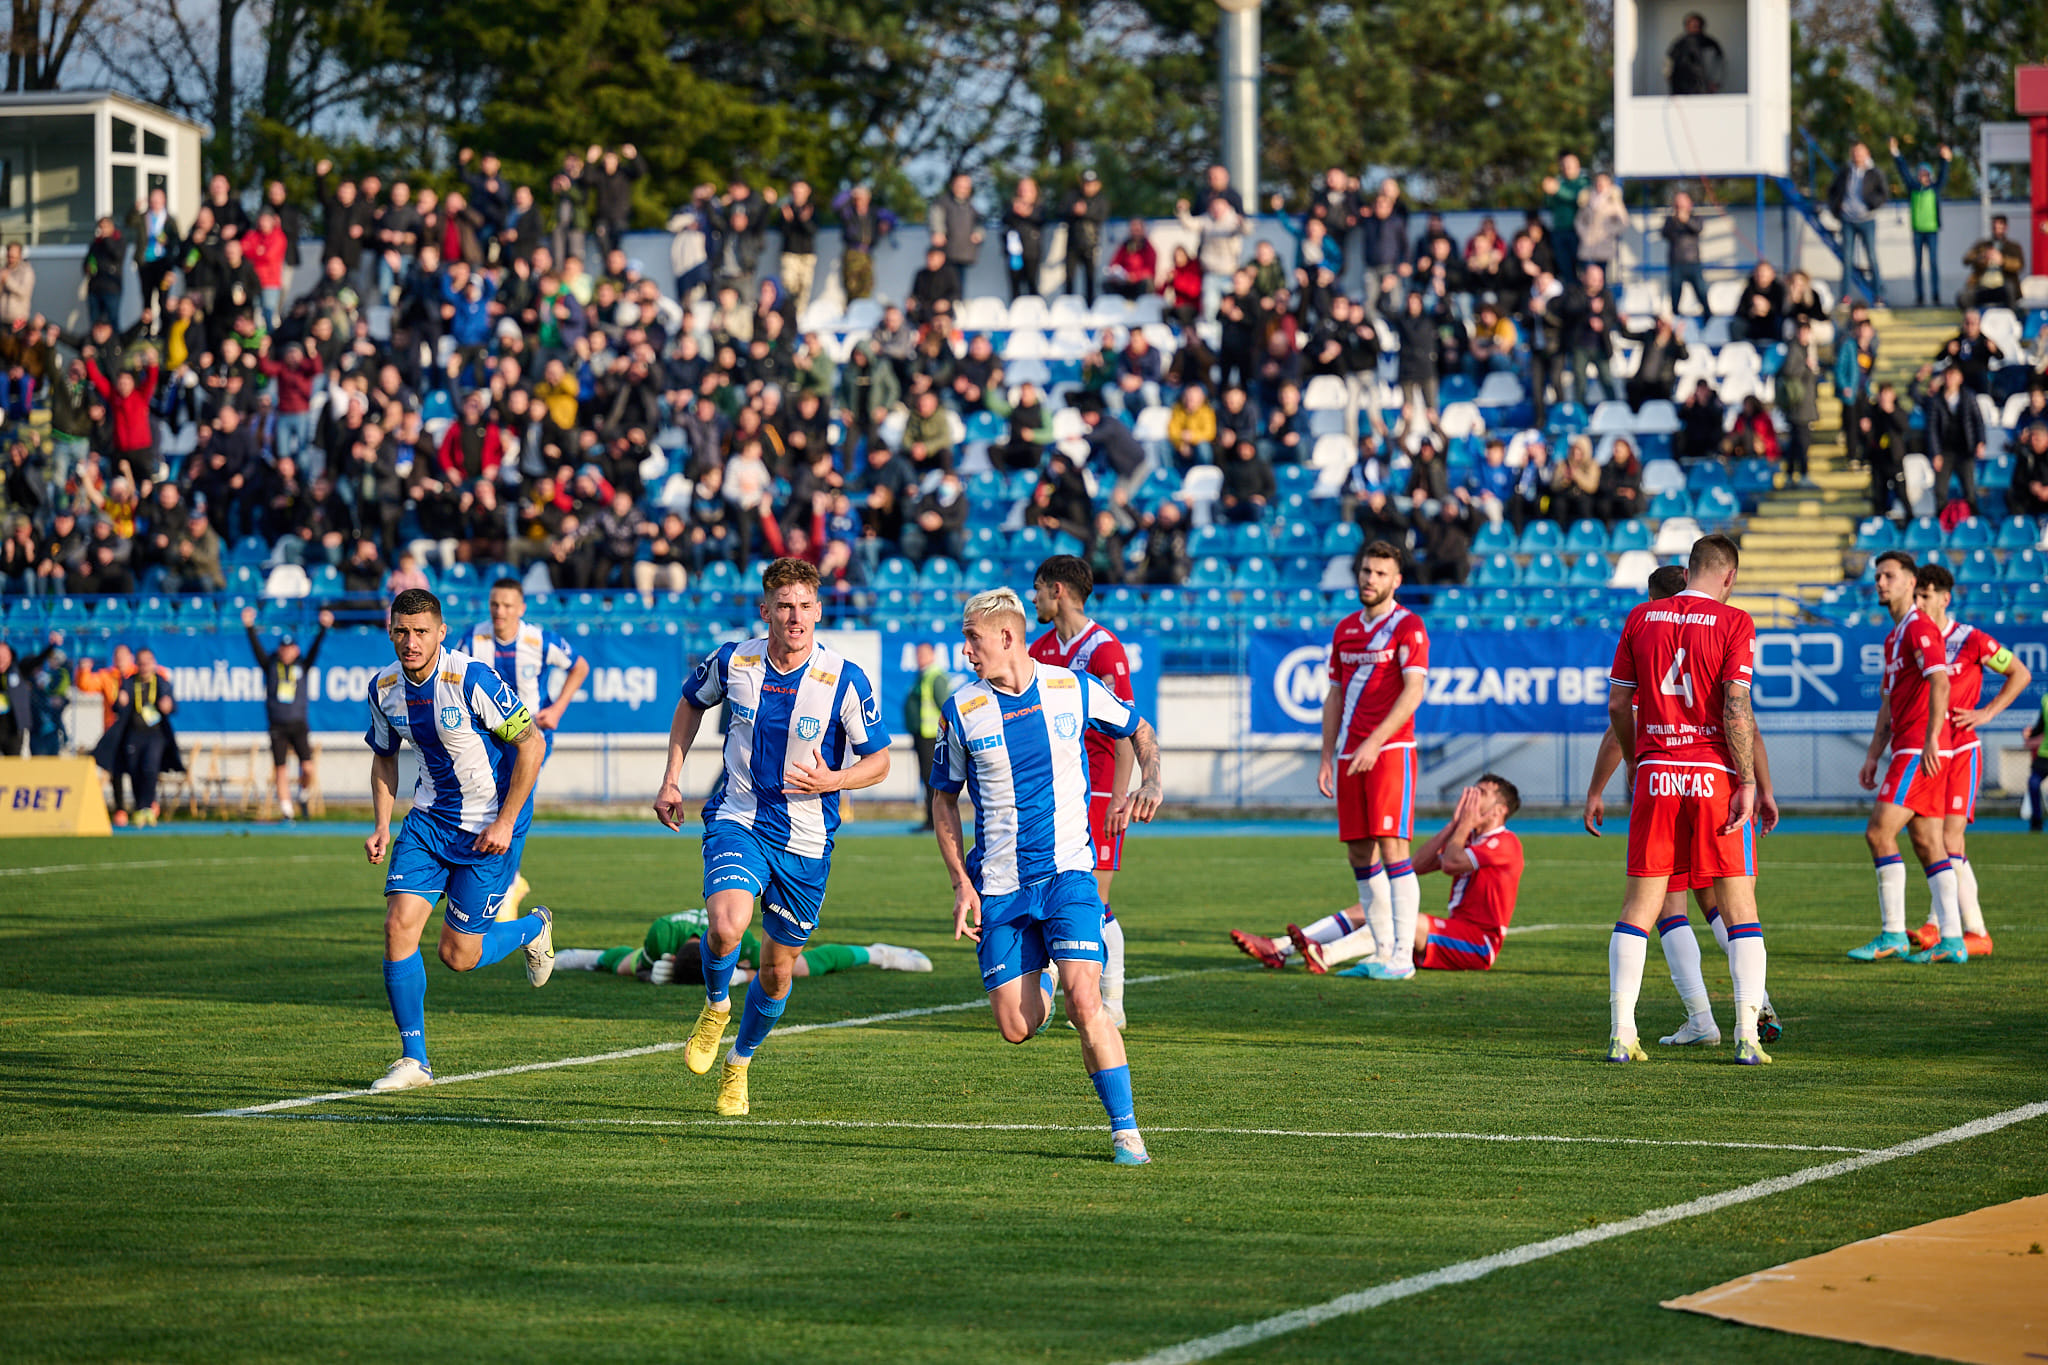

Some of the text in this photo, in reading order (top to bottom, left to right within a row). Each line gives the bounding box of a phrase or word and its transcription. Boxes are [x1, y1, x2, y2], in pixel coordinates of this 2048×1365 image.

[1686, 613, 1717, 627] BUZAU
[1660, 647, 1694, 708] 4
[1003, 704, 1043, 721] GIVOVA
[1666, 735, 1694, 747] BUZAU
[1649, 771, 1715, 798] CONCAS
[13, 785, 72, 811] BET
